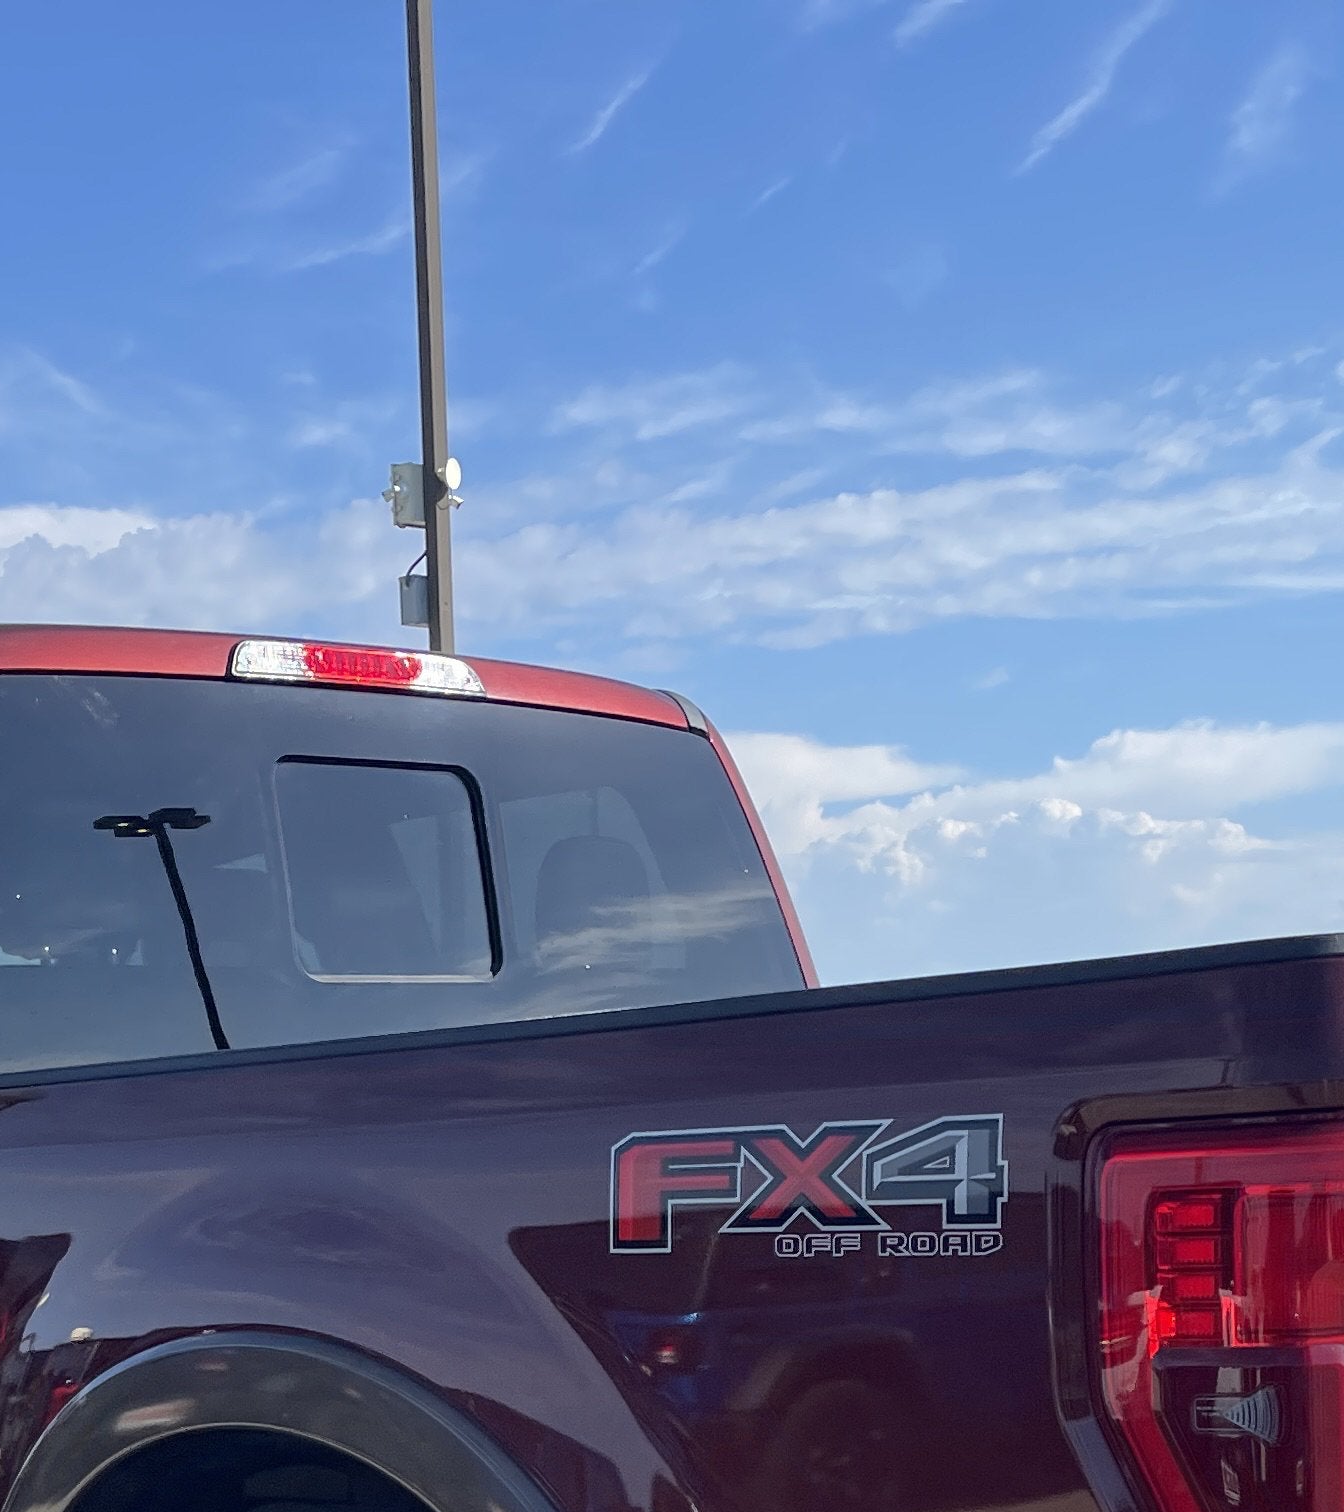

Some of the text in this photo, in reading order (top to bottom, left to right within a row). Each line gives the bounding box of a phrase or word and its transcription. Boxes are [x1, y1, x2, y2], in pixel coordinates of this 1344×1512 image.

[610, 1113, 1008, 1254] FX4
[775, 1231, 1003, 1258] OFF ROAD
